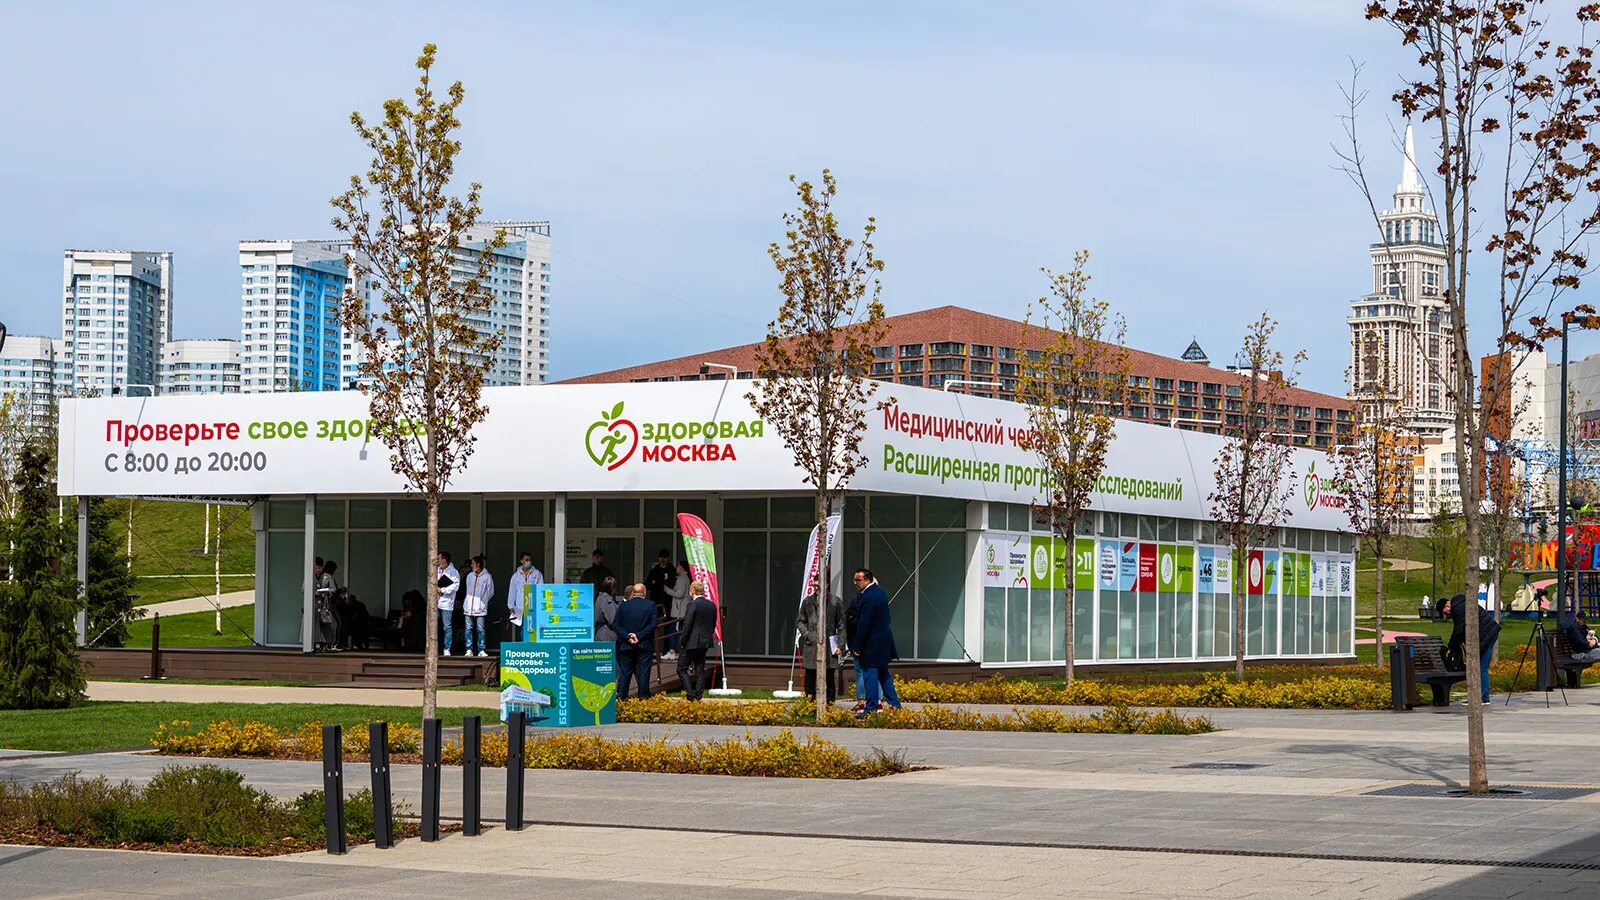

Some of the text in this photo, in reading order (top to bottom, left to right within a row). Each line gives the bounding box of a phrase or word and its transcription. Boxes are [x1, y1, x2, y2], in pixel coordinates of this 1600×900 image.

[106, 420, 240, 447] Проверьте
[247, 420, 308, 439] свое
[642, 421, 763, 443] ЗДОРОВАЯ
[883, 404, 1004, 445] Медицинский
[104, 451, 267, 475] С 8:00 до 20:00
[642, 444, 737, 463] МОСКВА
[883, 444, 1000, 484] Расширенная
[1203, 563, 1212, 577] 46
[505, 650, 549, 658] Проверить
[521, 666, 557, 675] здорово!
[559, 646, 567, 725] БЕСПЛАТНО
